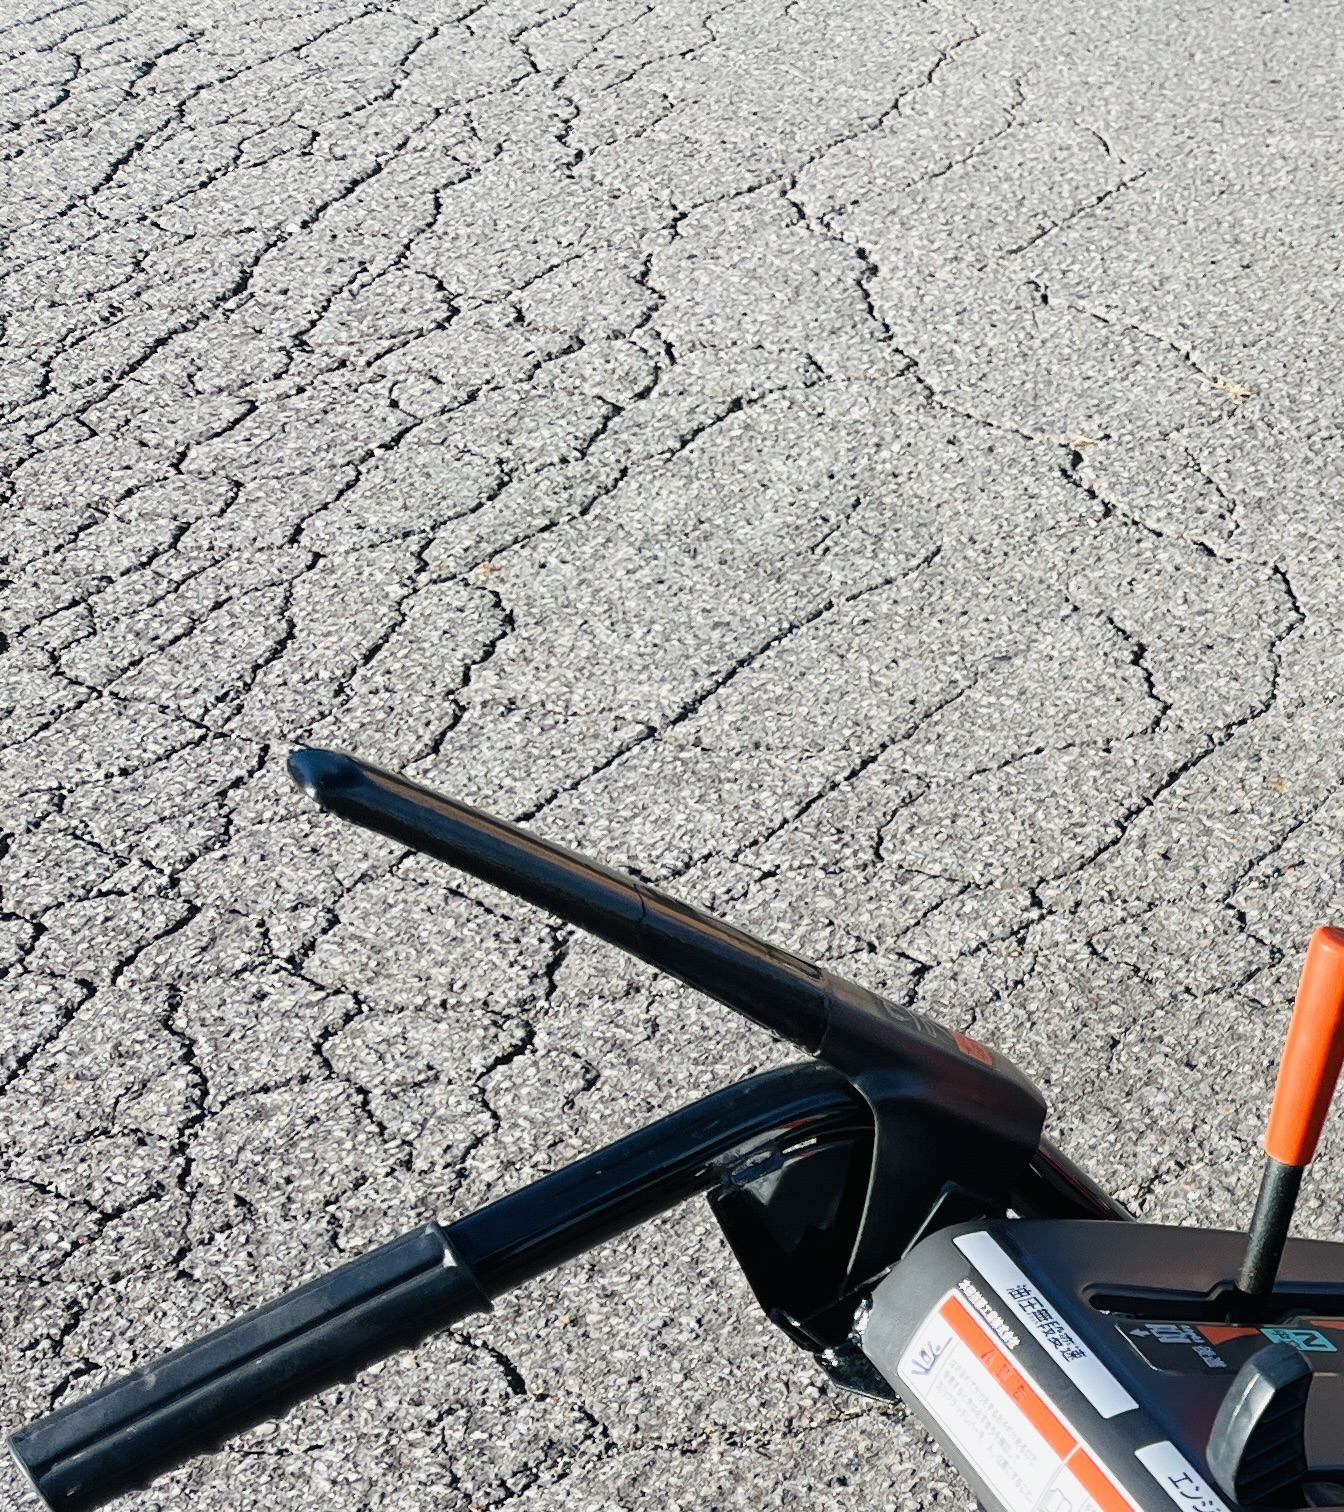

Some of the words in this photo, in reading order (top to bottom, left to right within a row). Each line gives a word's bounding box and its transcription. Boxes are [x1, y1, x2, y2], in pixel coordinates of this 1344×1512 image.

[1006, 1284, 1087, 1362] 油圧無段変速
[1293, 1331, 1328, 1349] N
